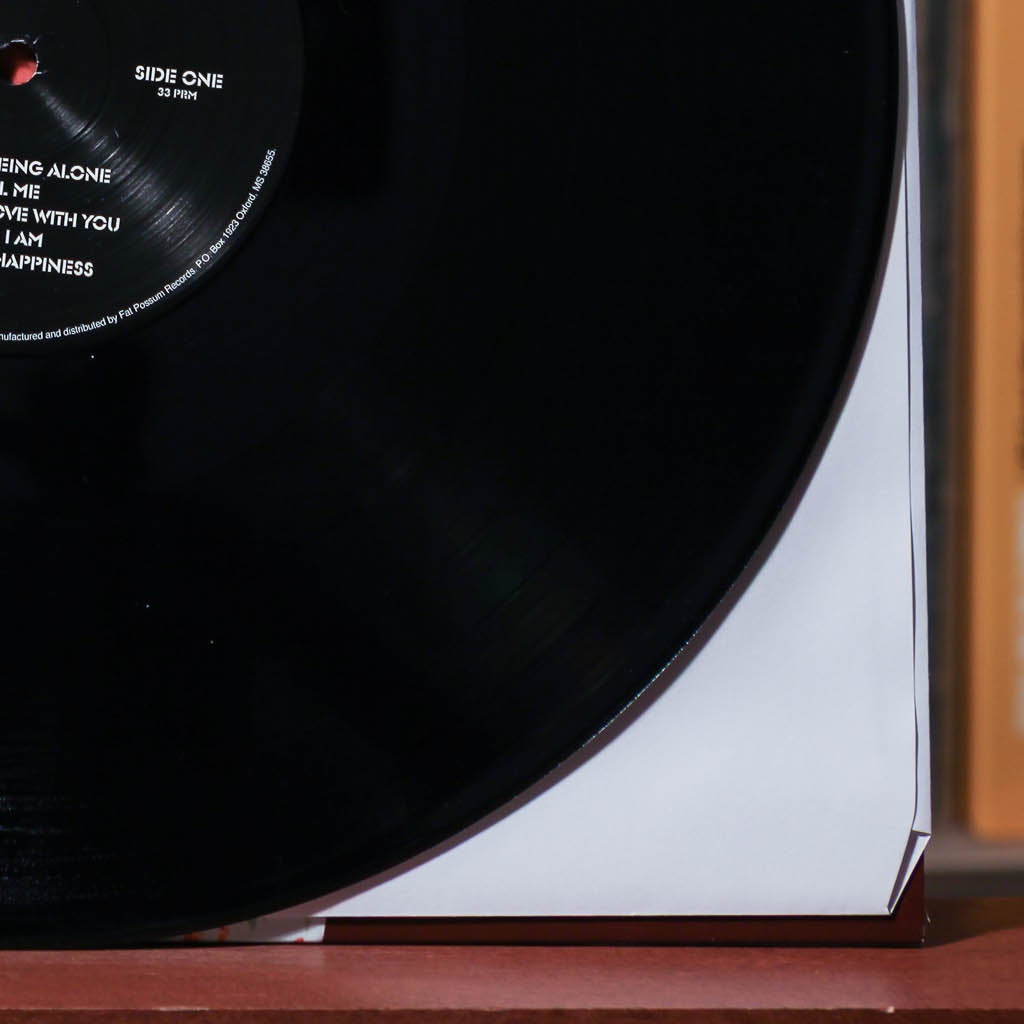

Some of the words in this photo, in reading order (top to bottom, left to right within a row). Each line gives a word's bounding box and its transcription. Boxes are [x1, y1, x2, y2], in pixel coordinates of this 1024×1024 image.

[135, 65, 177, 84] SIDE
[182, 70, 224, 89] ONE
[157, 87, 171, 97] 33
[173, 88, 198, 101] PRM
[47, 163, 112, 184] ALONE
[12, 182, 41, 200] ME
[32, 208, 77, 228] WITH
[81, 213, 121, 232] YOU
[4, 229, 10, 244] I
[13, 231, 44, 248] AM
[45, 329, 62, 339] and
[63, 318, 106, 337] distributed
[106, 314, 118, 324] by
[118, 307, 133, 319] Fat
[133, 291, 166, 312] Possum
[209, 238, 225, 254] Box
[223, 219, 240, 239] 1923
[252, 176, 265, 192] MS
